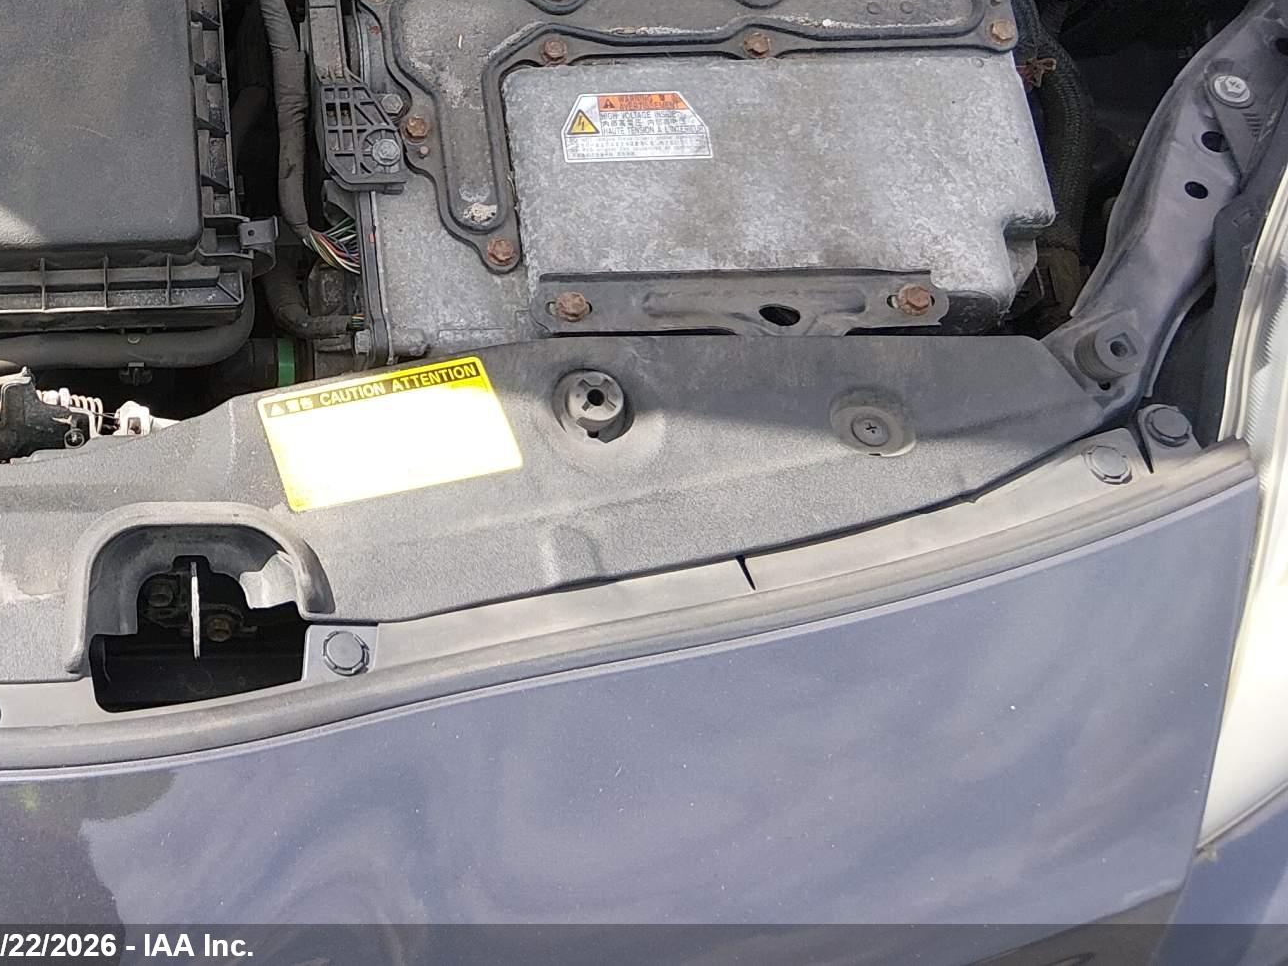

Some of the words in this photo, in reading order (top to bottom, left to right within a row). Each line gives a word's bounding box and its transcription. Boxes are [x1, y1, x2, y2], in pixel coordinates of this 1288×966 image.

[601, 112, 618, 120] HIGH
[319, 381, 386, 407] CAUTION
[392, 364, 478, 393] ATTENTION
